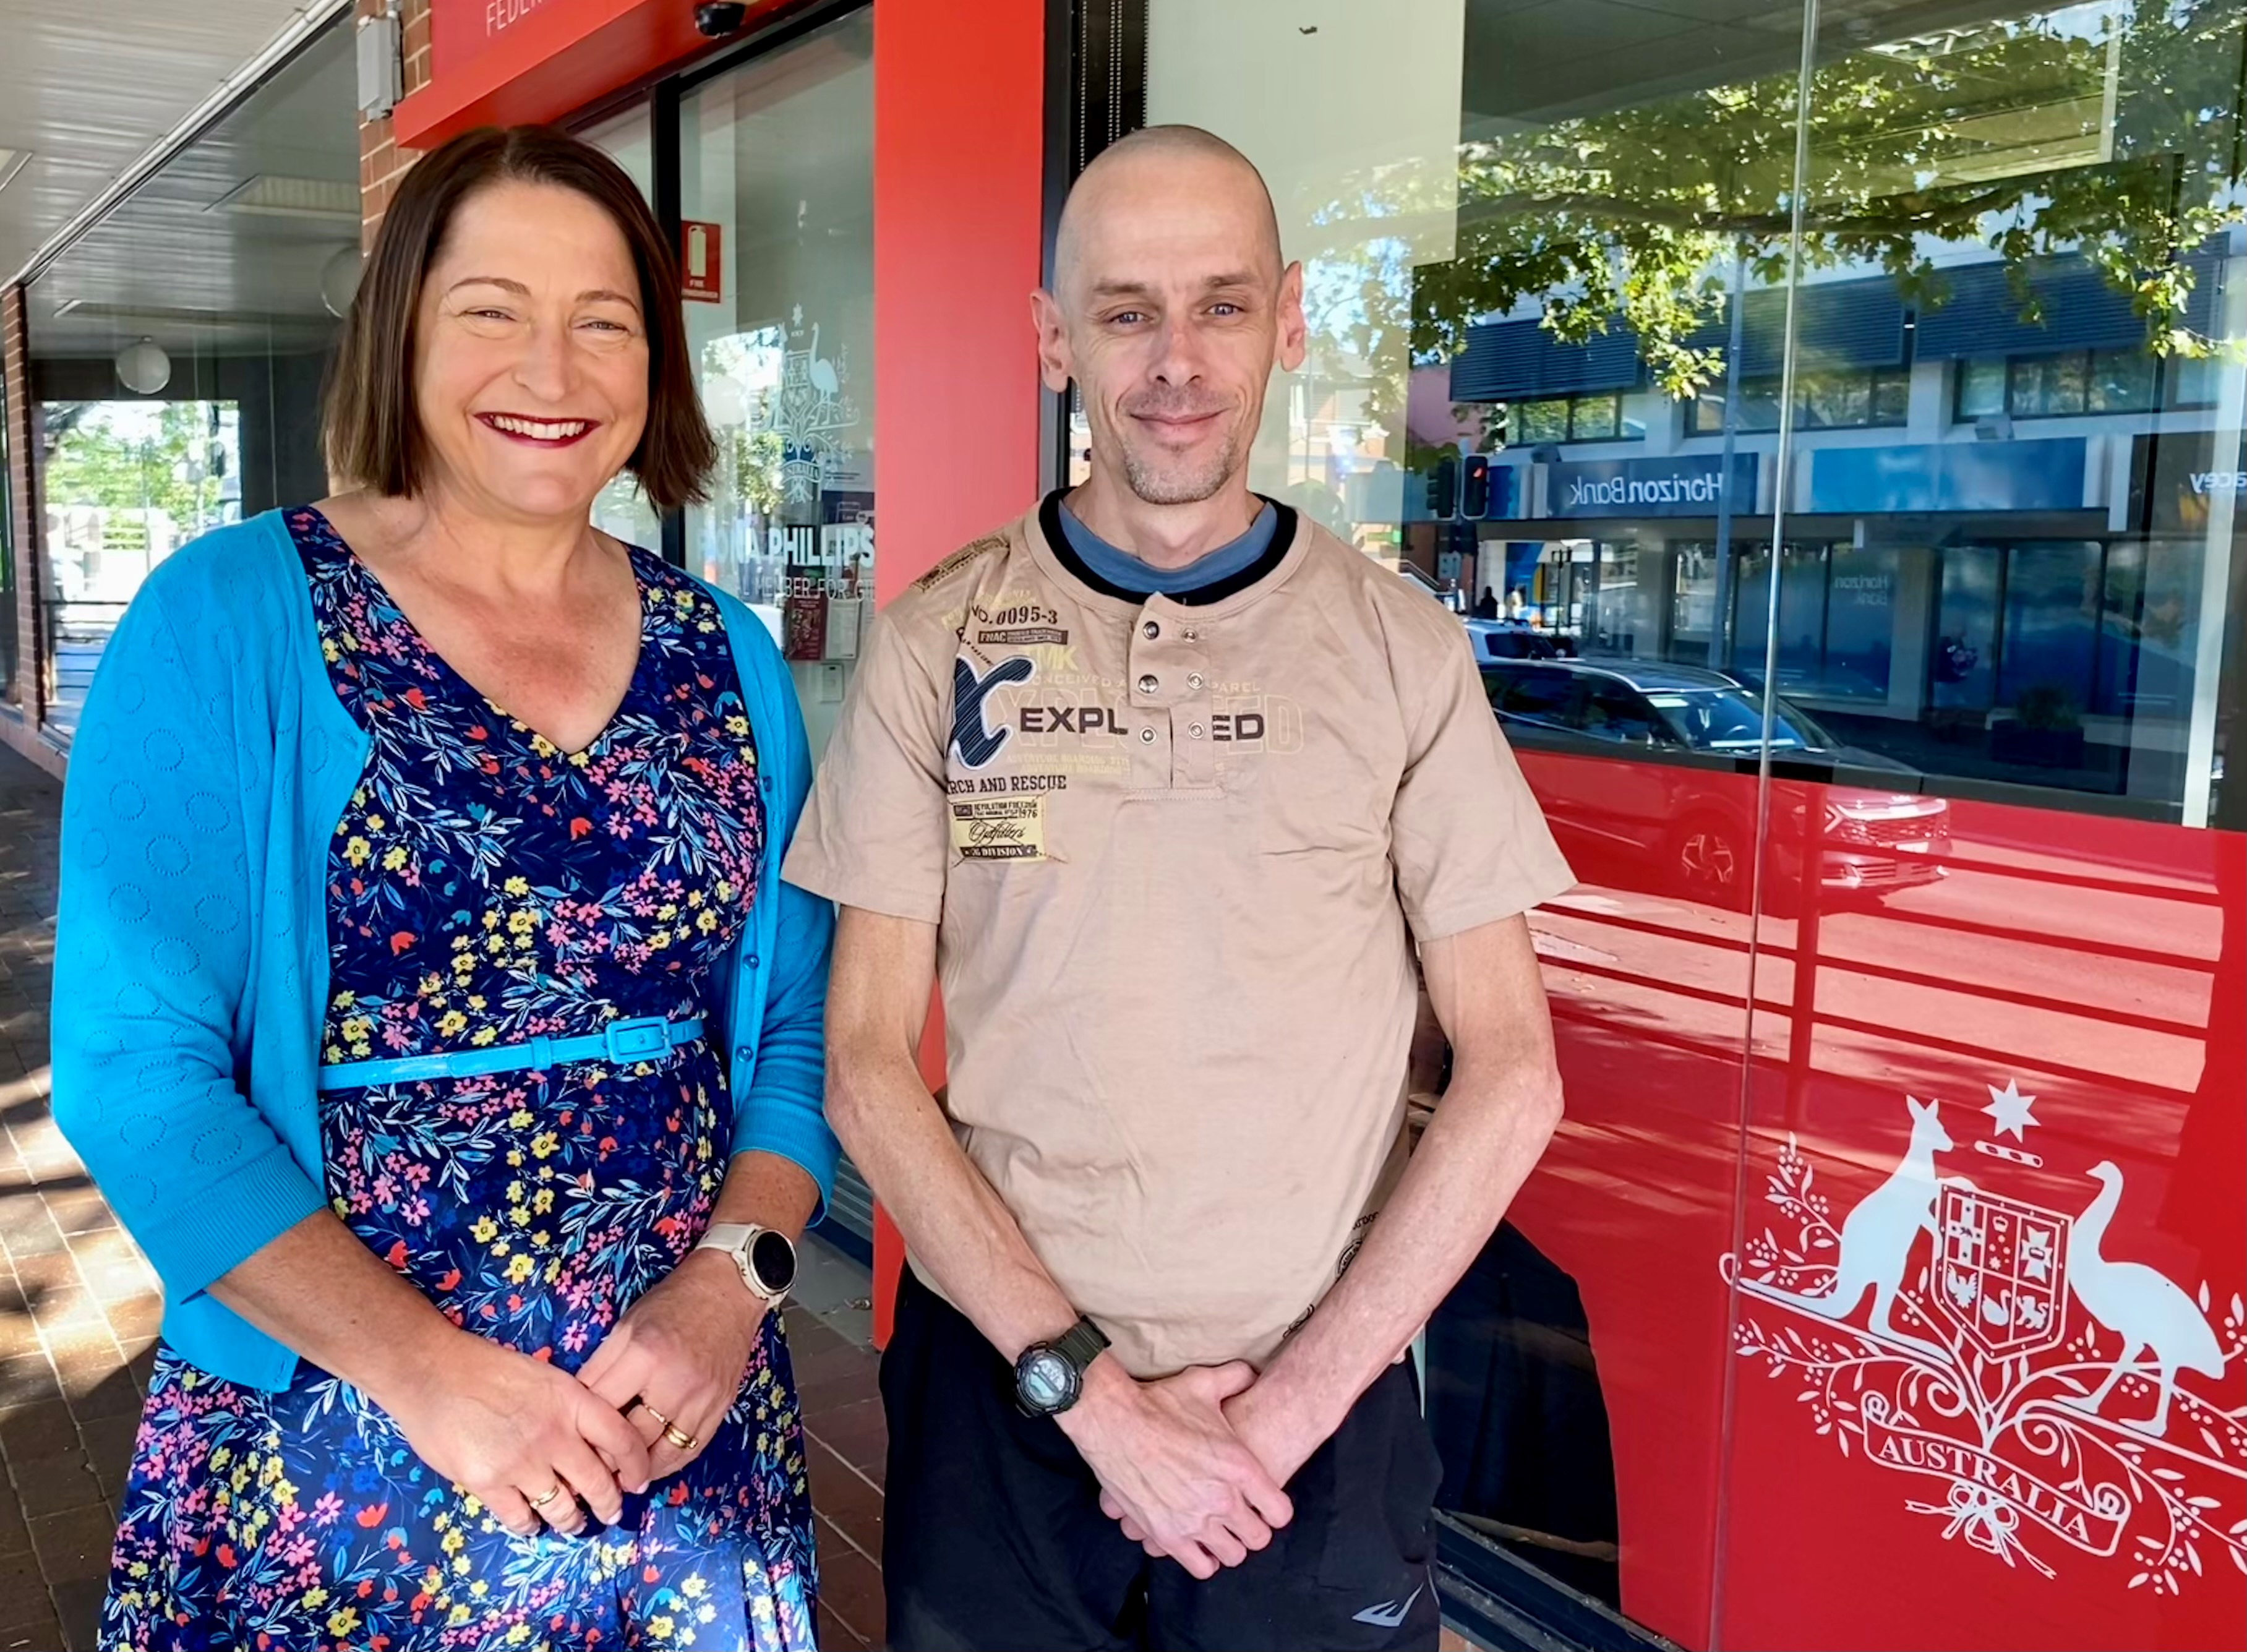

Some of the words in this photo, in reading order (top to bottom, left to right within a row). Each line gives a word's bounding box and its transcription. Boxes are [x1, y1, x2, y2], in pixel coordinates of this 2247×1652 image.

[768, 526, 875, 568] PHILLIPS
[818, 578, 846, 600] FOR
[1032, 672, 1111, 688] ONCEIVED
[1020, 707, 1129, 735] EXPL
[1212, 714, 1265, 741] ED
[978, 777, 1007, 793] AND
[1010, 775, 1067, 791] RESCUE
[982, 847, 1023, 857] DIVISION
[1878, 1435, 2091, 1544] AUSTRALIA
